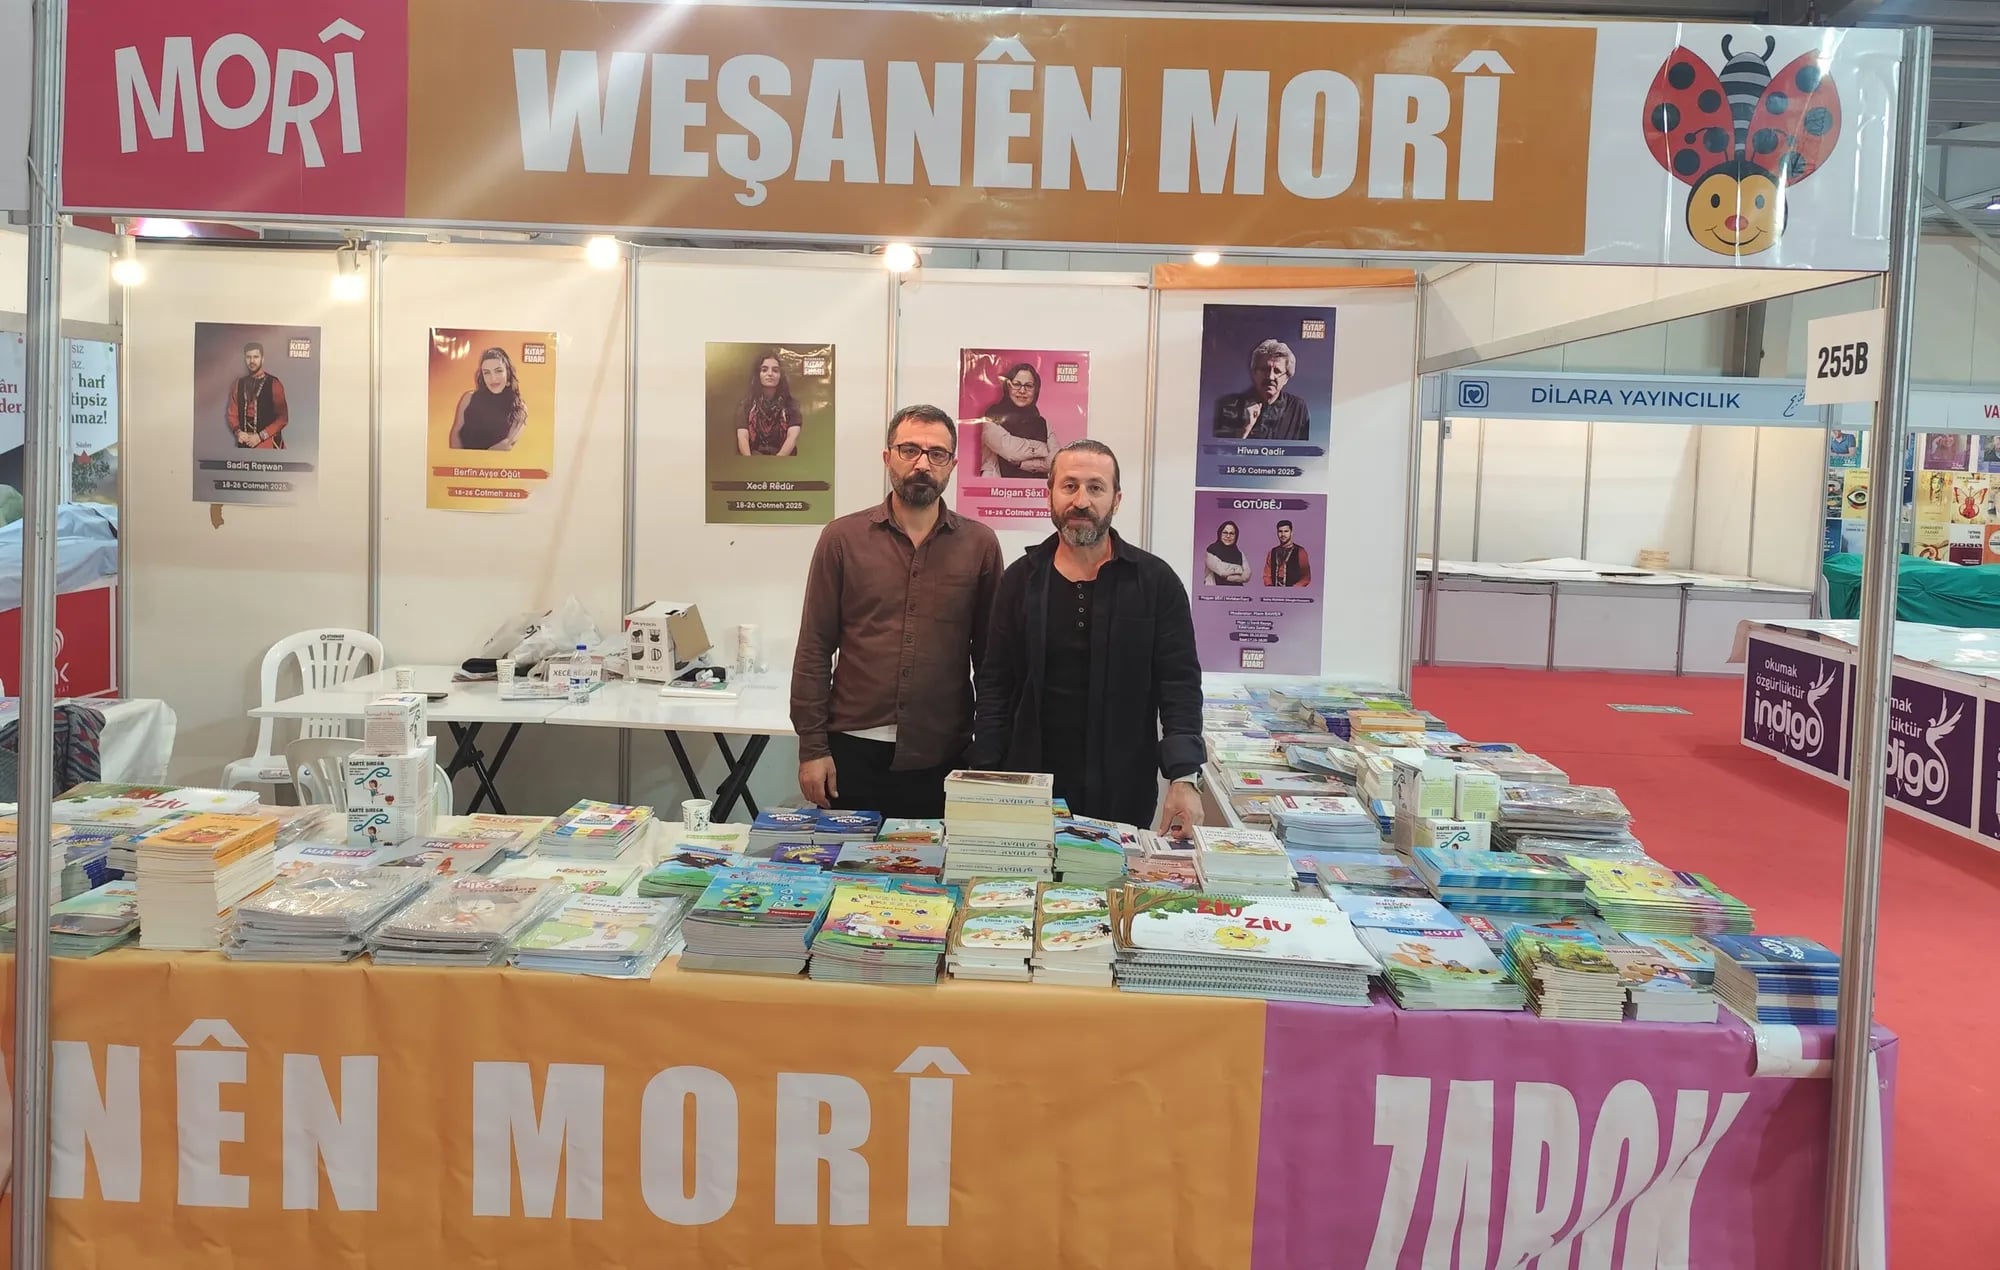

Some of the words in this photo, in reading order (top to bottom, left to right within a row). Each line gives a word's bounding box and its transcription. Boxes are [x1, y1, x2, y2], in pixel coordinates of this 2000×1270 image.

[115, 17, 365, 168] MORÎ
[512, 37, 1122, 207] WEŞANÊN
[1158, 50, 1516, 202] MORÎ
[1816, 340, 1870, 380] 255B
[78, 373, 106, 389] harf
[1531, 383, 1614, 406] DİLARA
[1619, 389, 1741, 410] YAYINCILIK
[1248, 466, 1276, 474] Cotmeh
[1277, 467, 1295, 475] 2025
[474, 488, 503, 497] Cotmeh
[990, 487, 1023, 499] Mojgan
[1233, 498, 1282, 510] GOTÛBÊJ
[1004, 508, 1034, 517] Cotmeh
[1764, 657, 1798, 678] okumak
[1755, 672, 1805, 700] özgürlüktür
[1754, 690, 1822, 751] indigo
[0, 1018, 379, 1212] NÊN
[472, 1045, 971, 1227] MORÎ
